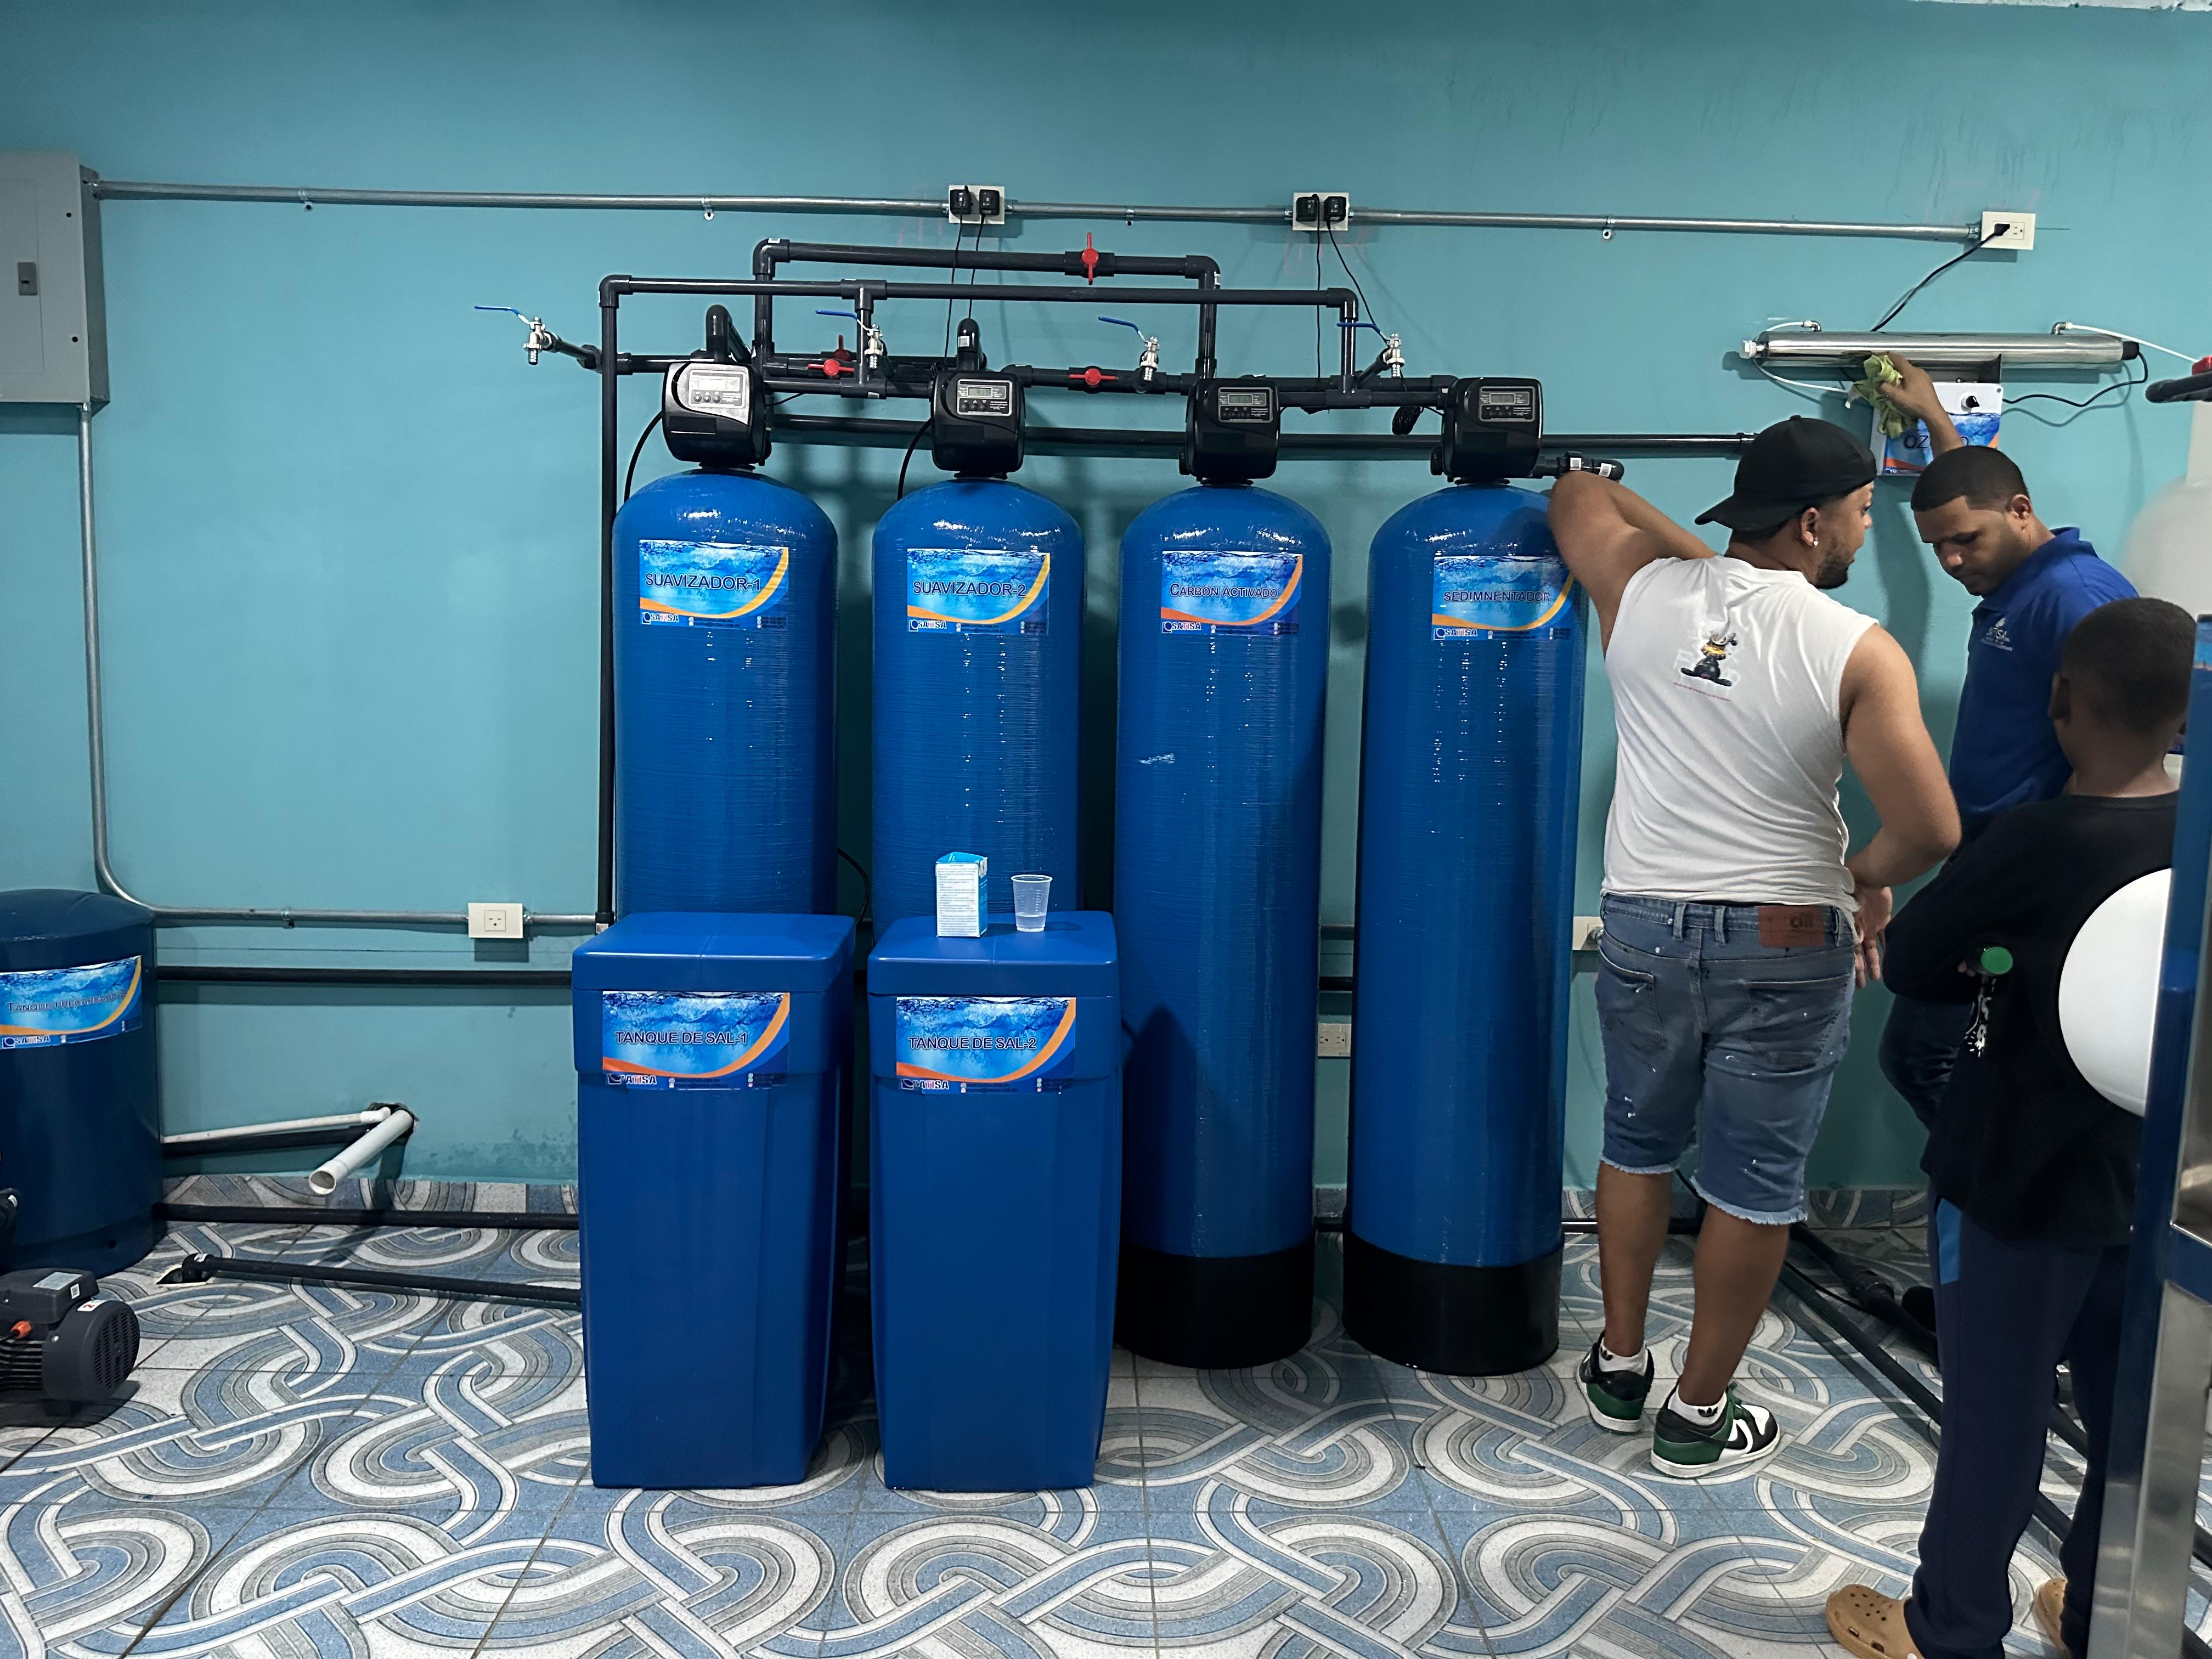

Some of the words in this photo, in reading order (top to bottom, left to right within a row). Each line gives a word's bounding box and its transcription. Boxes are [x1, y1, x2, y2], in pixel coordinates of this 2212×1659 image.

[646, 573, 761, 591] SUAVIZADOR-1
[913, 580, 1026, 597] SUAVIZADOR-2
[1443, 591, 1550, 602] SEDIMNENTADOR
[7, 1003, 53, 1012] TANQUE
[615, 1031, 678, 1045] TANQUE
[681, 1031, 703, 1043] DE
[706, 1031, 747, 1044] SAL-1
[909, 1037, 969, 1050] TANQUE
[972, 1037, 992, 1049] DE
[995, 1037, 1036, 1049] SAL-2
